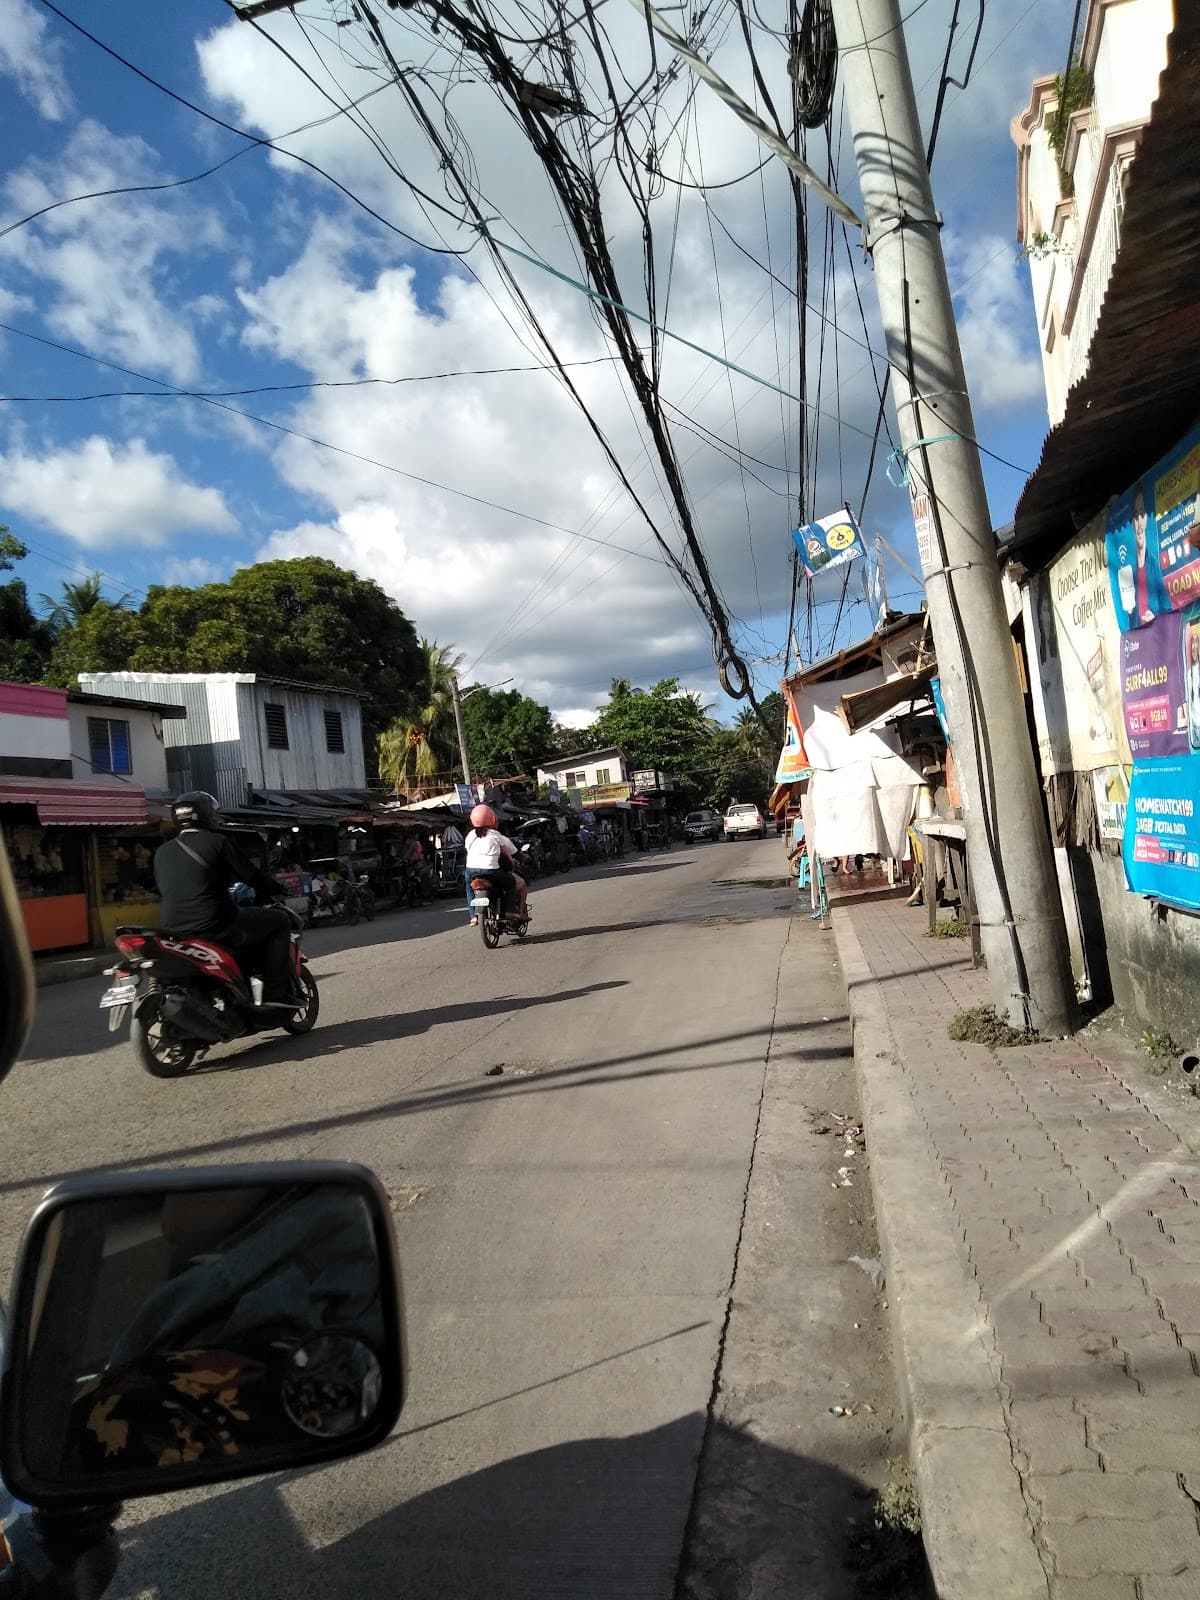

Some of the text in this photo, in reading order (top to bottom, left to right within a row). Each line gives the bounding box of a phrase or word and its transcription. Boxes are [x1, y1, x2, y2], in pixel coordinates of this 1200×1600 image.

[1080, 557, 1093, 584] The
[1168, 573, 1192, 597] LOAD
[1072, 586, 1107, 629] Coffee Mix
[1125, 665, 1168, 693] SURF4ALL99
[1135, 798, 1194, 817] HOMEWATCH199
[1155, 820, 1174, 835] TOTAL
